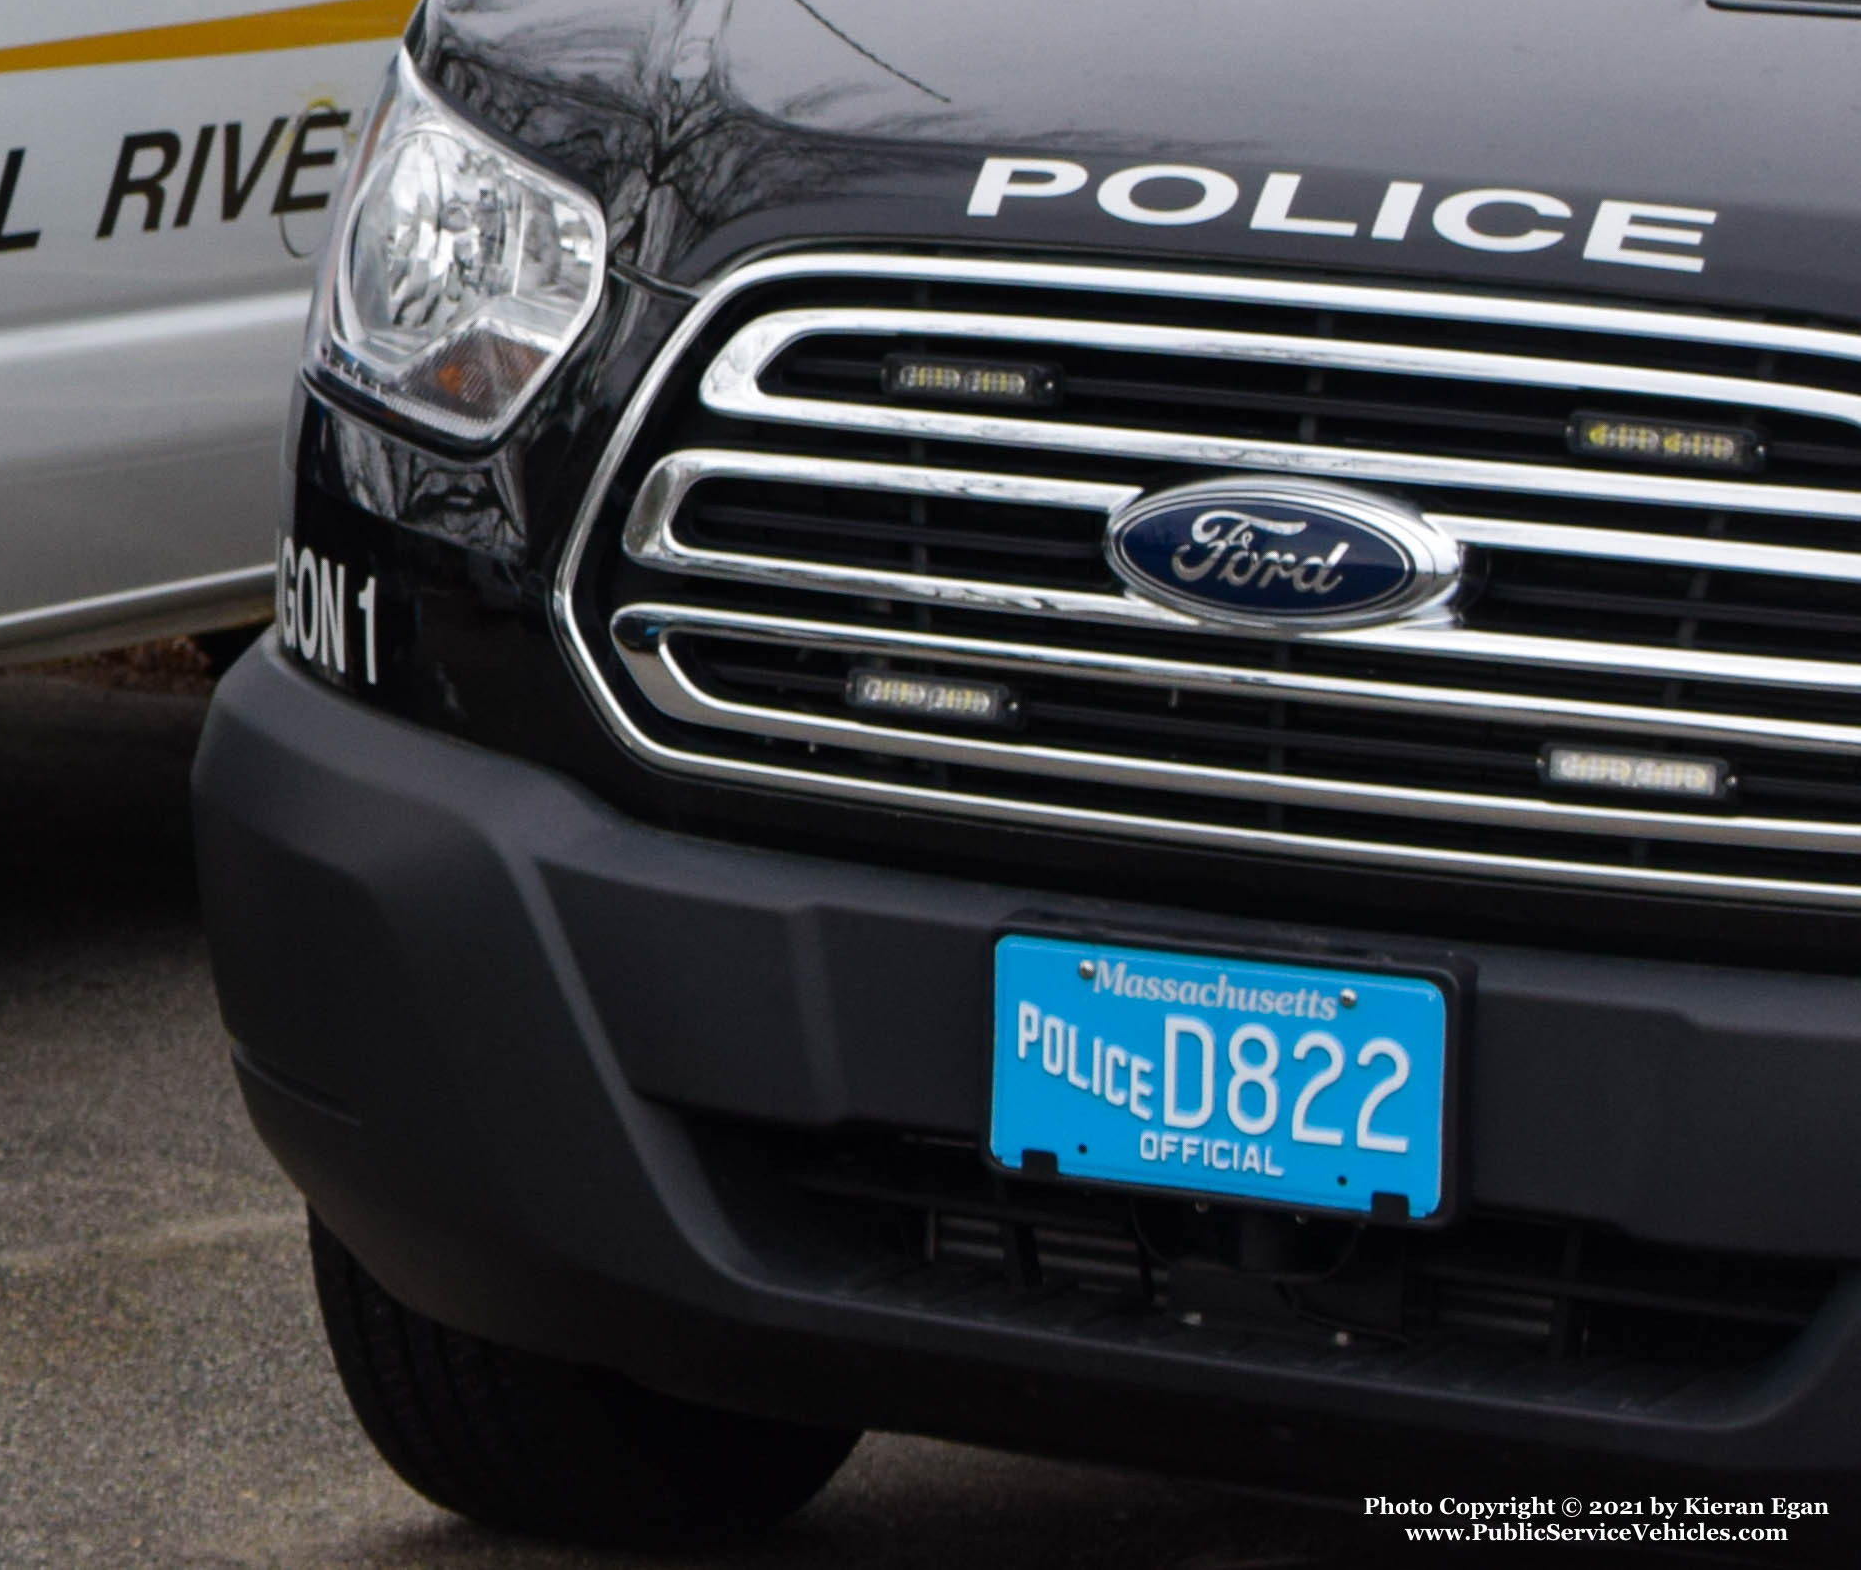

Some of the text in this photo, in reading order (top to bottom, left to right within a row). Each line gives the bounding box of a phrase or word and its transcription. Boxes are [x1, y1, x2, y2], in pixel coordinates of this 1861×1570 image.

[95, 110, 352, 239] RIVE
[966, 157, 1718, 273] POLICE
[1172, 509, 1351, 594] Ford
[357, 576, 377, 685] 1
[1093, 959, 1339, 1022] Massachusetts
[1016, 1001, 1411, 1155] POLICE D822
[1139, 1130, 1285, 1178] OFFICIAL
